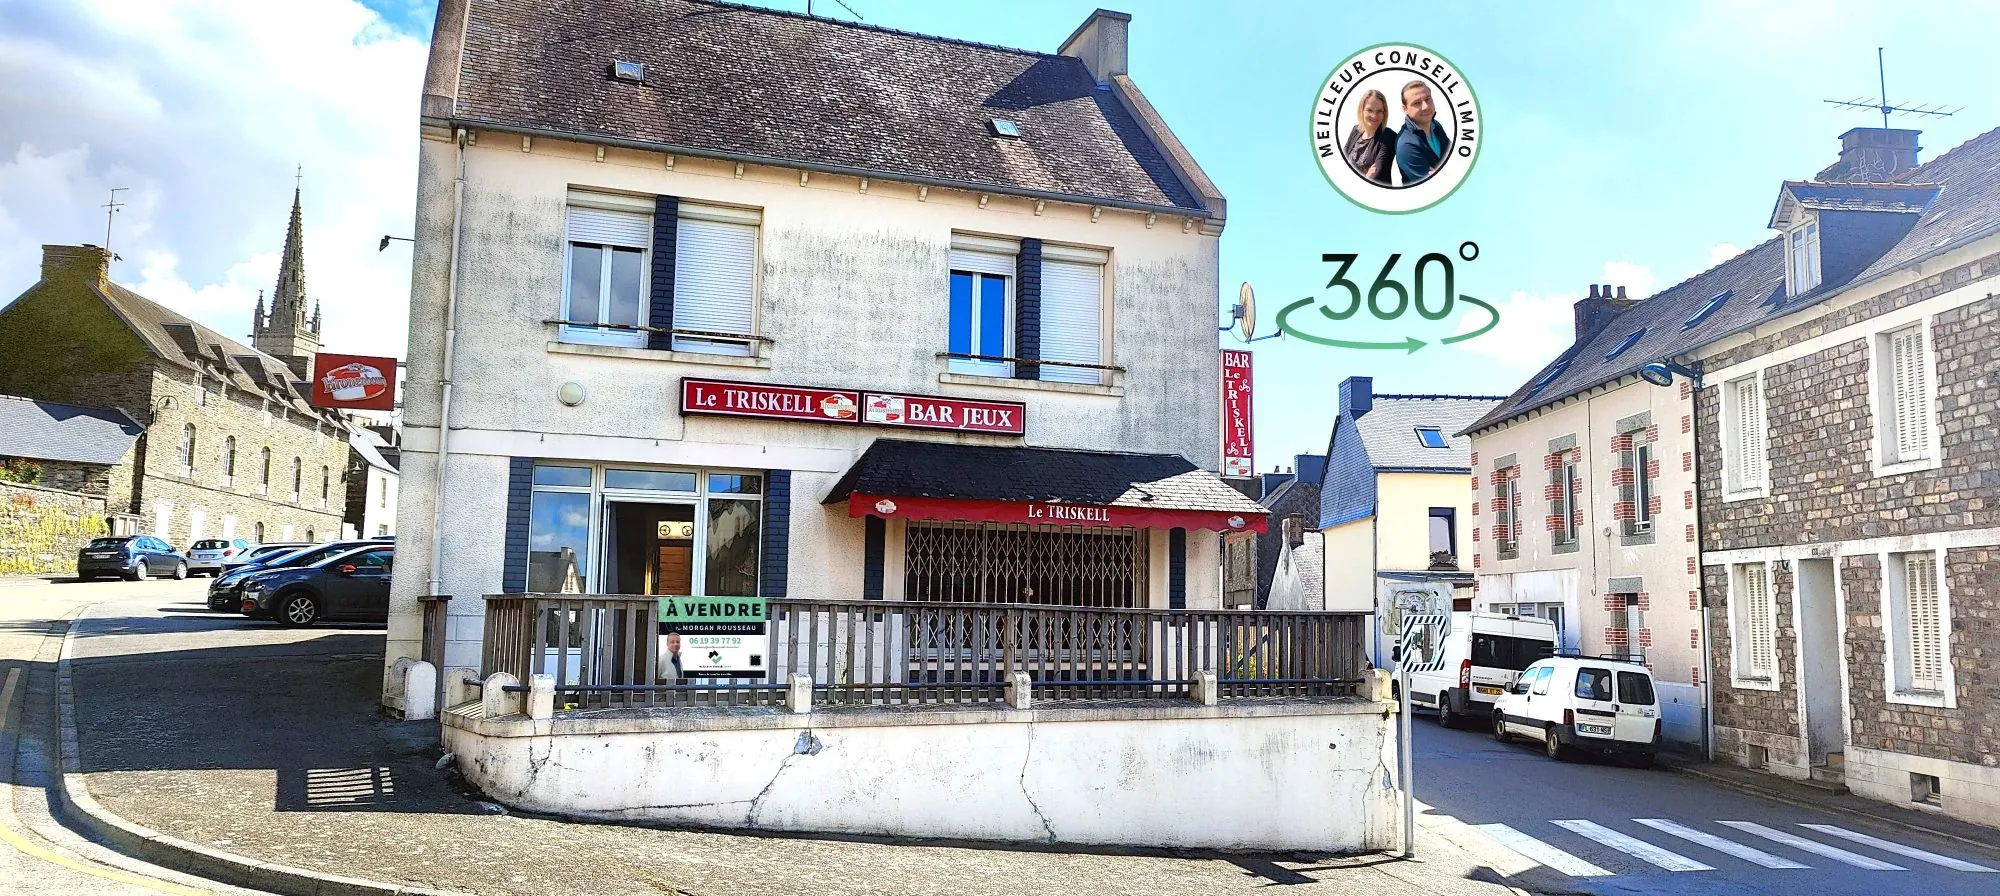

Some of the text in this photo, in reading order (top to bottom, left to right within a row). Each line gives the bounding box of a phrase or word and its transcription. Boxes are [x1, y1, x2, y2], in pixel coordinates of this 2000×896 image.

[1225, 353, 1250, 368] BAR
[1225, 369, 1240, 379] Le
[696, 388, 816, 413] Le TRISKELL
[909, 403, 1013, 428] BAR JEUX
[1225, 380, 1251, 456] TRISKELL
[1028, 505, 1110, 521] Le TRISKELL
[666, 598, 761, 616] À VENDRE
